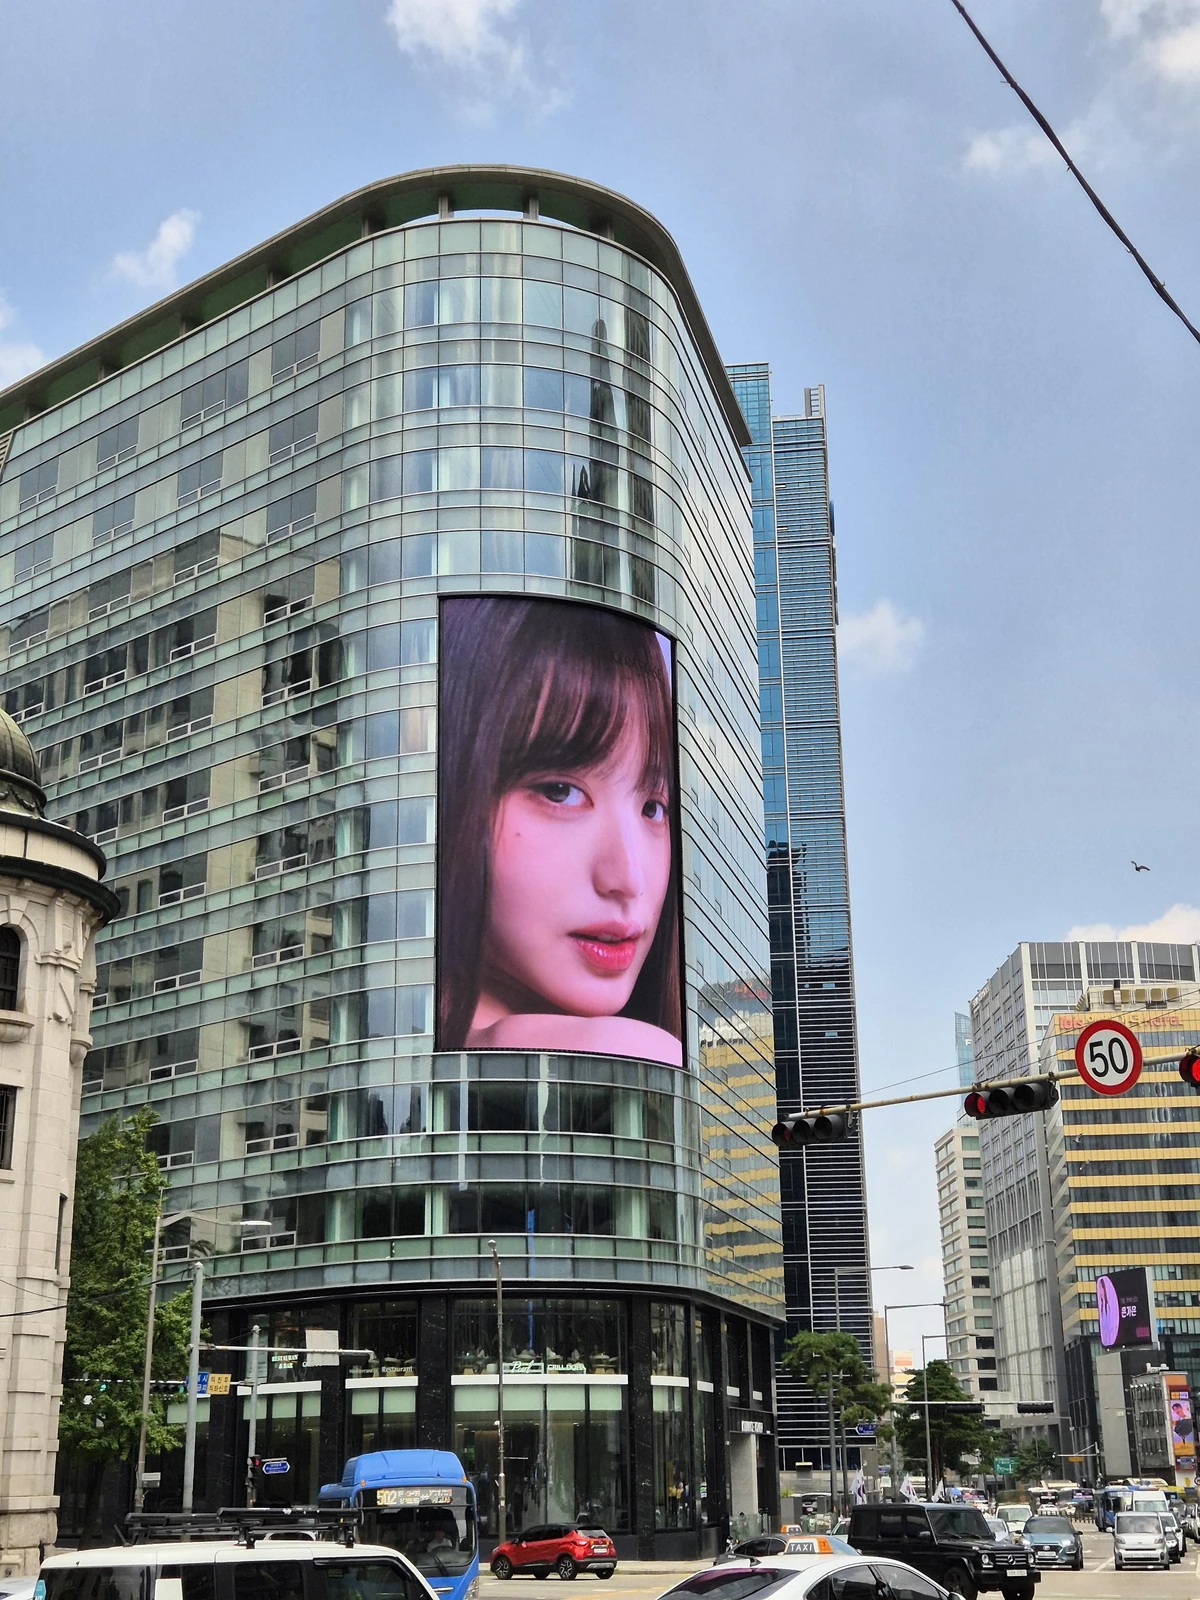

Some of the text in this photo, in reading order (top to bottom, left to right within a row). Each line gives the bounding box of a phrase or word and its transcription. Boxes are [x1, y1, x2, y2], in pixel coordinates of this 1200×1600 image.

[1059, 1016, 1084, 1030] ibis
[1088, 1036, 1129, 1078] 50
[376, 1489, 397, 1505] 502
[790, 1543, 812, 1552] TAXI
